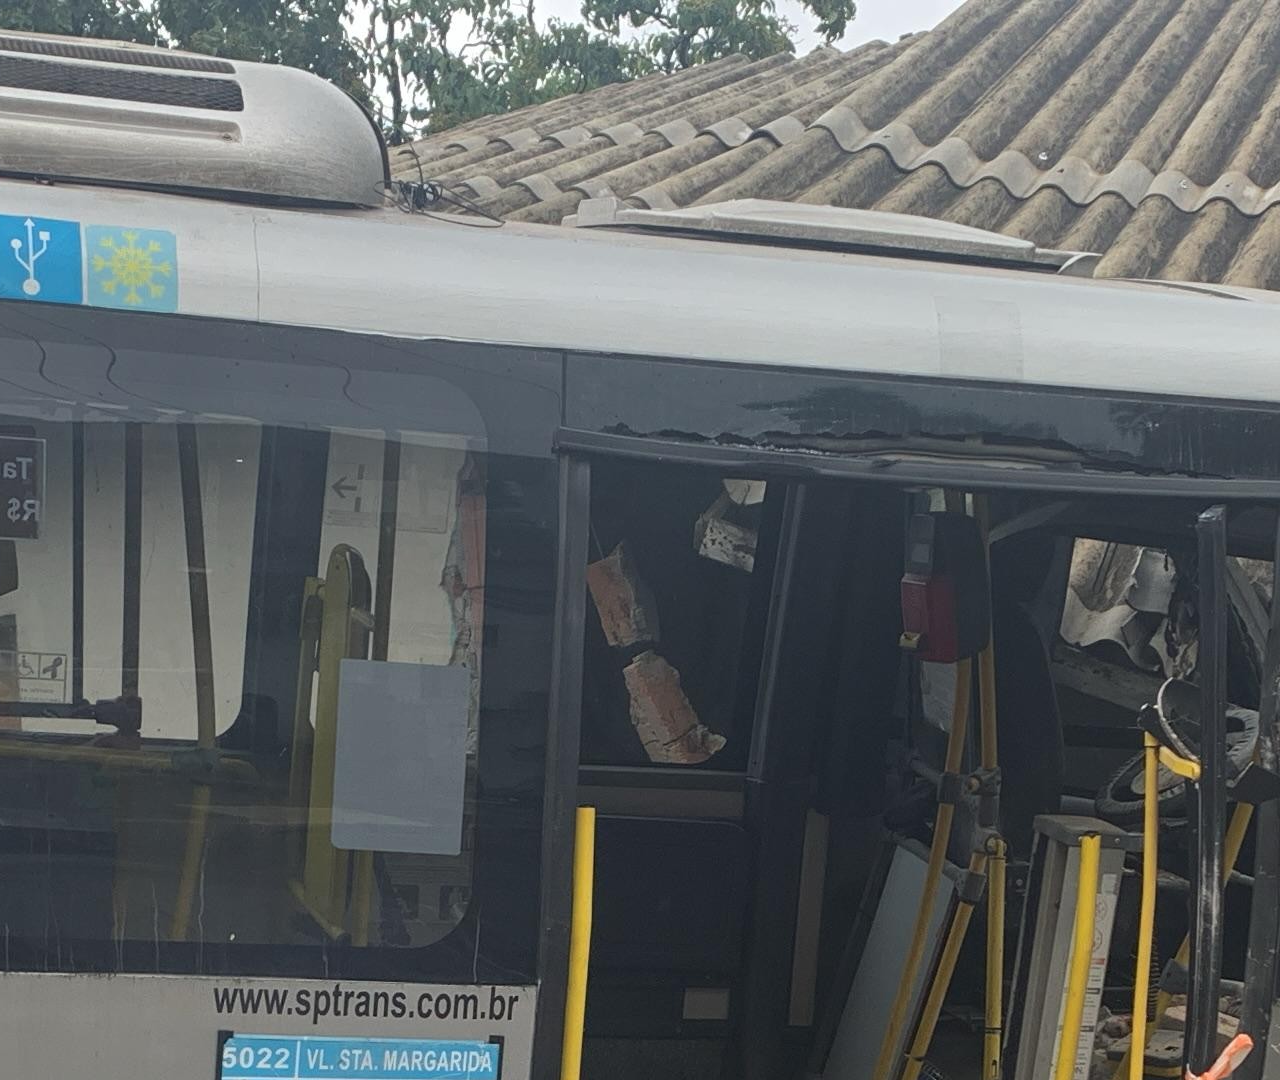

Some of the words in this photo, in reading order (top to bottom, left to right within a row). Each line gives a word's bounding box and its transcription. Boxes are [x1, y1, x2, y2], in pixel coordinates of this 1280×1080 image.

[214, 983, 519, 1025] www.sptrans.com.br
[222, 1046, 290, 1069] 5022
[307, 1049, 334, 1071] VL.
[339, 1049, 379, 1072] STA.
[383, 1050, 493, 1073] MARGARIDA
